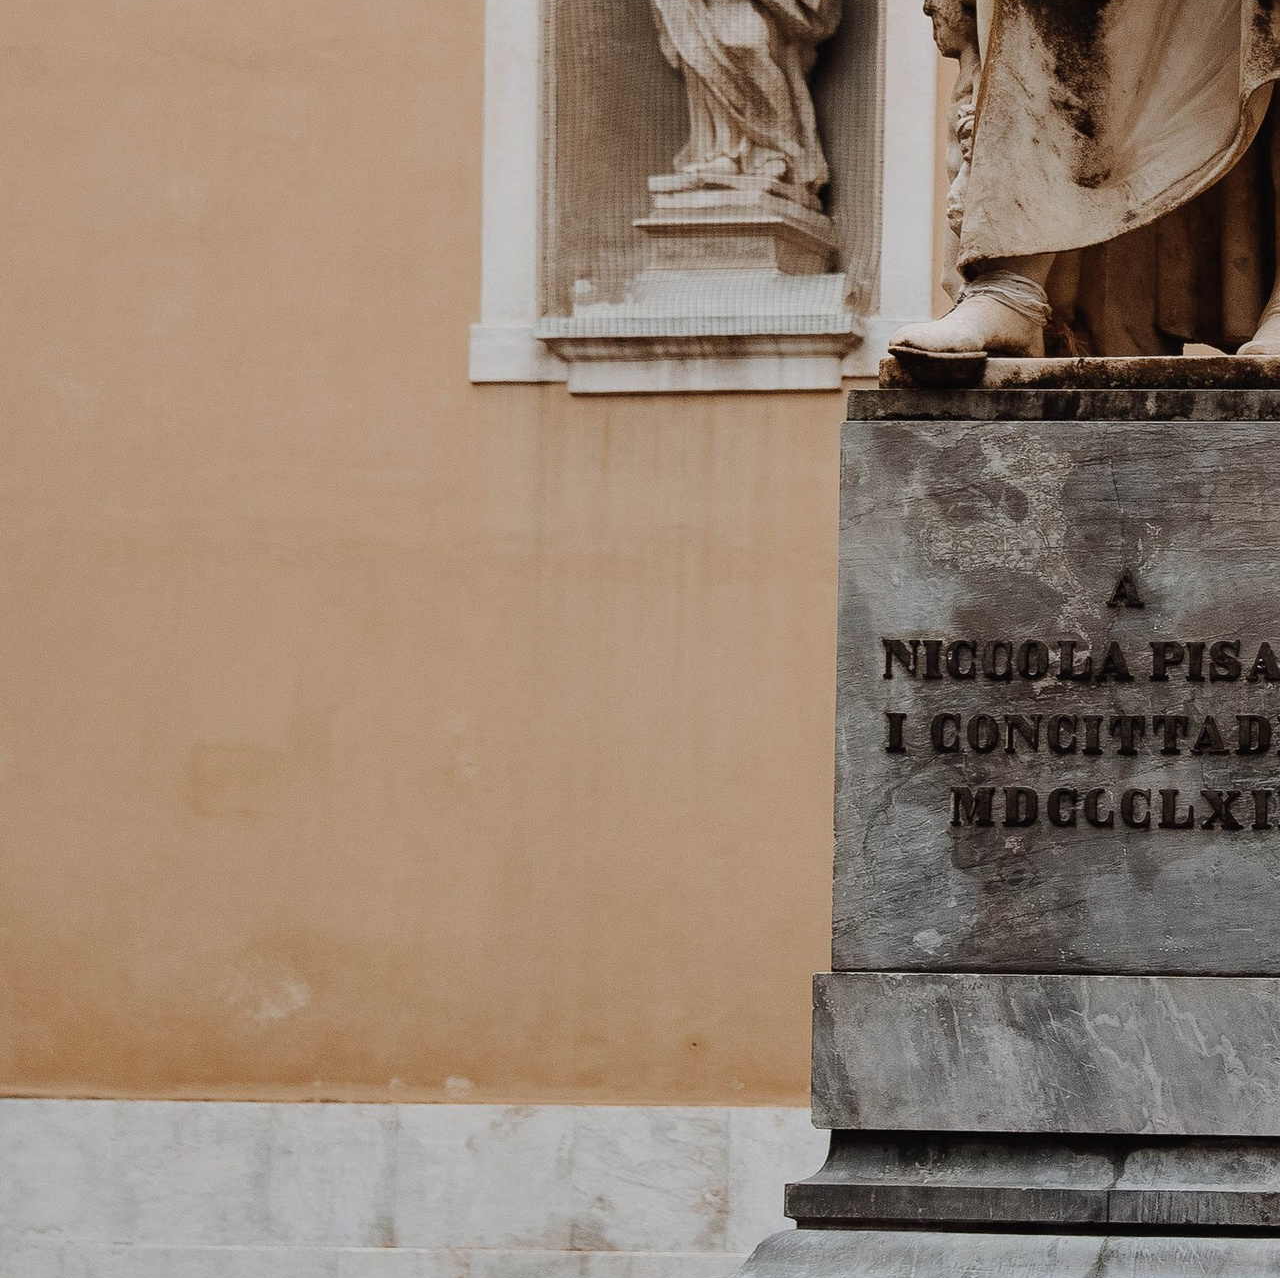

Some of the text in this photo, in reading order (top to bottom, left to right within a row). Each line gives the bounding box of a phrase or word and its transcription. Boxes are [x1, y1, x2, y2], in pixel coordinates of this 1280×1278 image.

[1105, 568, 1145, 609] A
[881, 638, 1134, 682] NICCOLA
[884, 712, 908, 754] I
